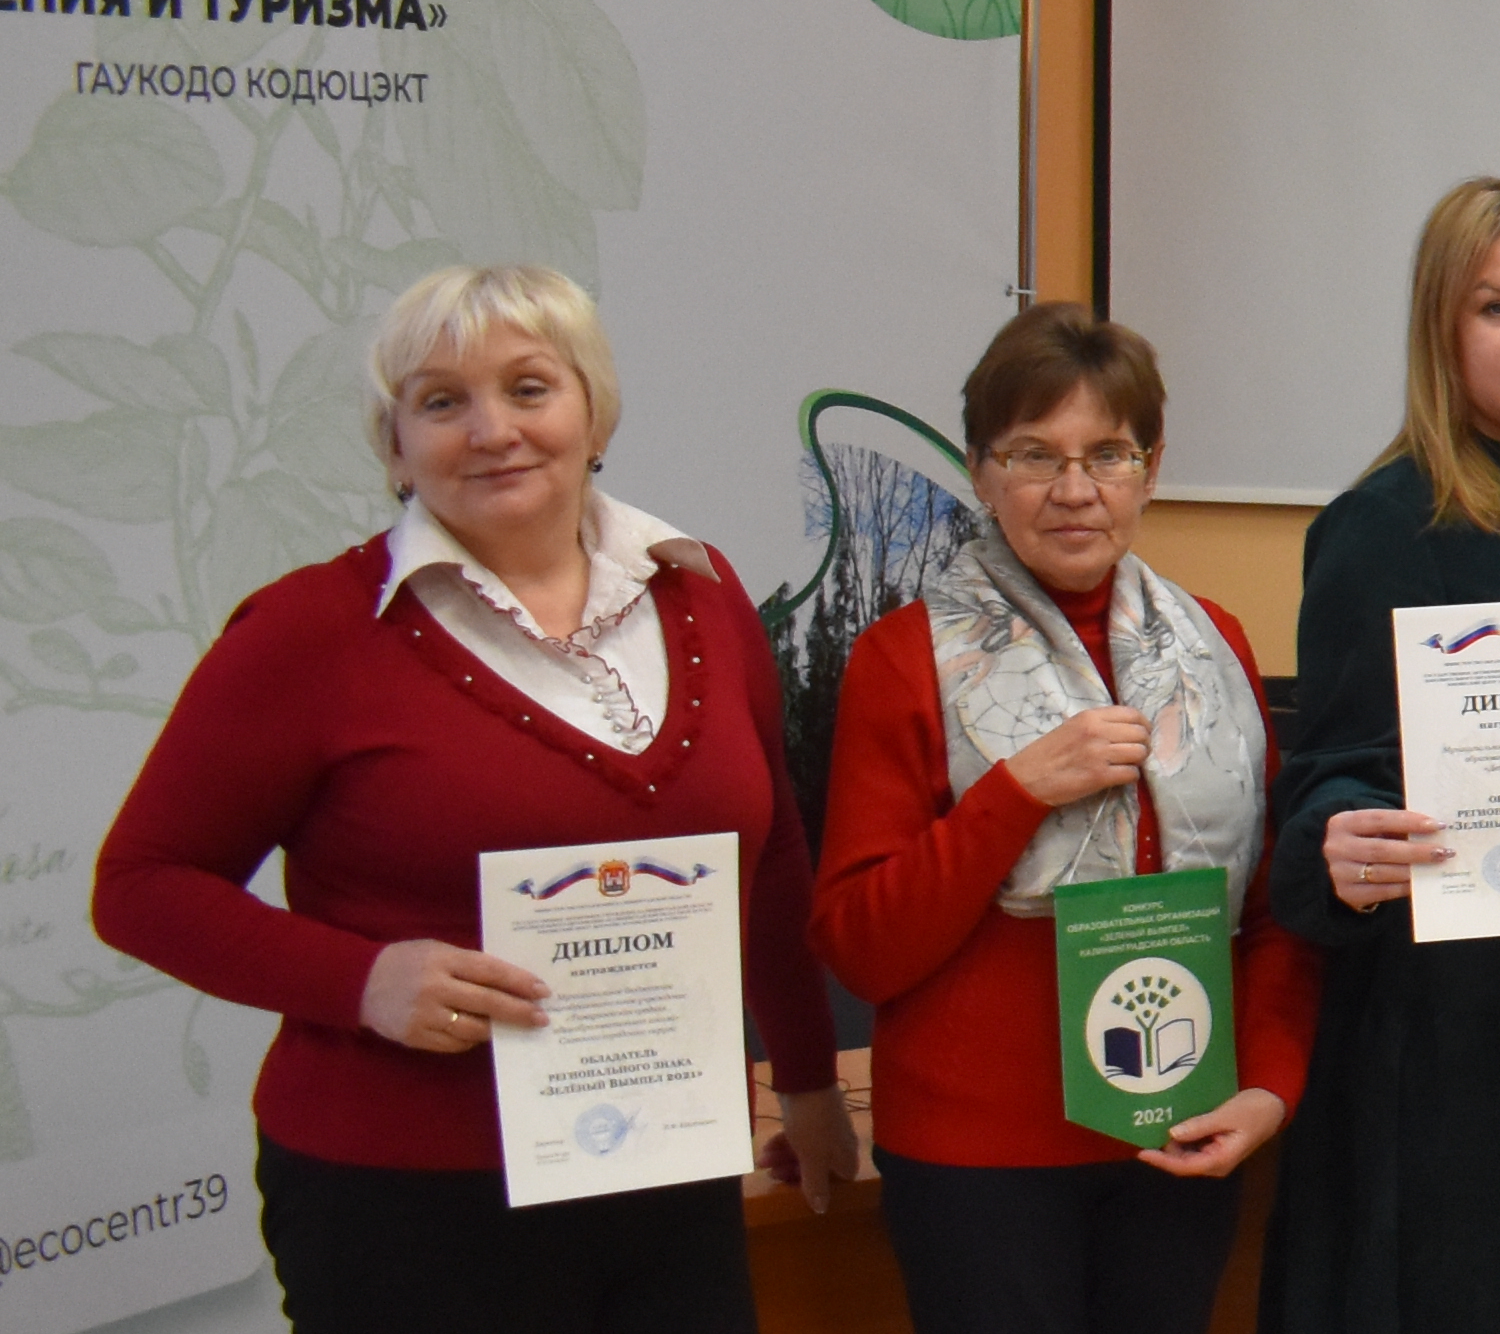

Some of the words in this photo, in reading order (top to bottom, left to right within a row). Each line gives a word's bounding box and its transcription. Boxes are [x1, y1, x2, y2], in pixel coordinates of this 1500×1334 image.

[75, 61, 236, 102] ГАУКОДО
[247, 66, 429, 108] КОДЮЦЭКТ
[552, 931, 674, 963] ДИПЛОМ
[0, 1173, 228, 1275] ecocentr39
